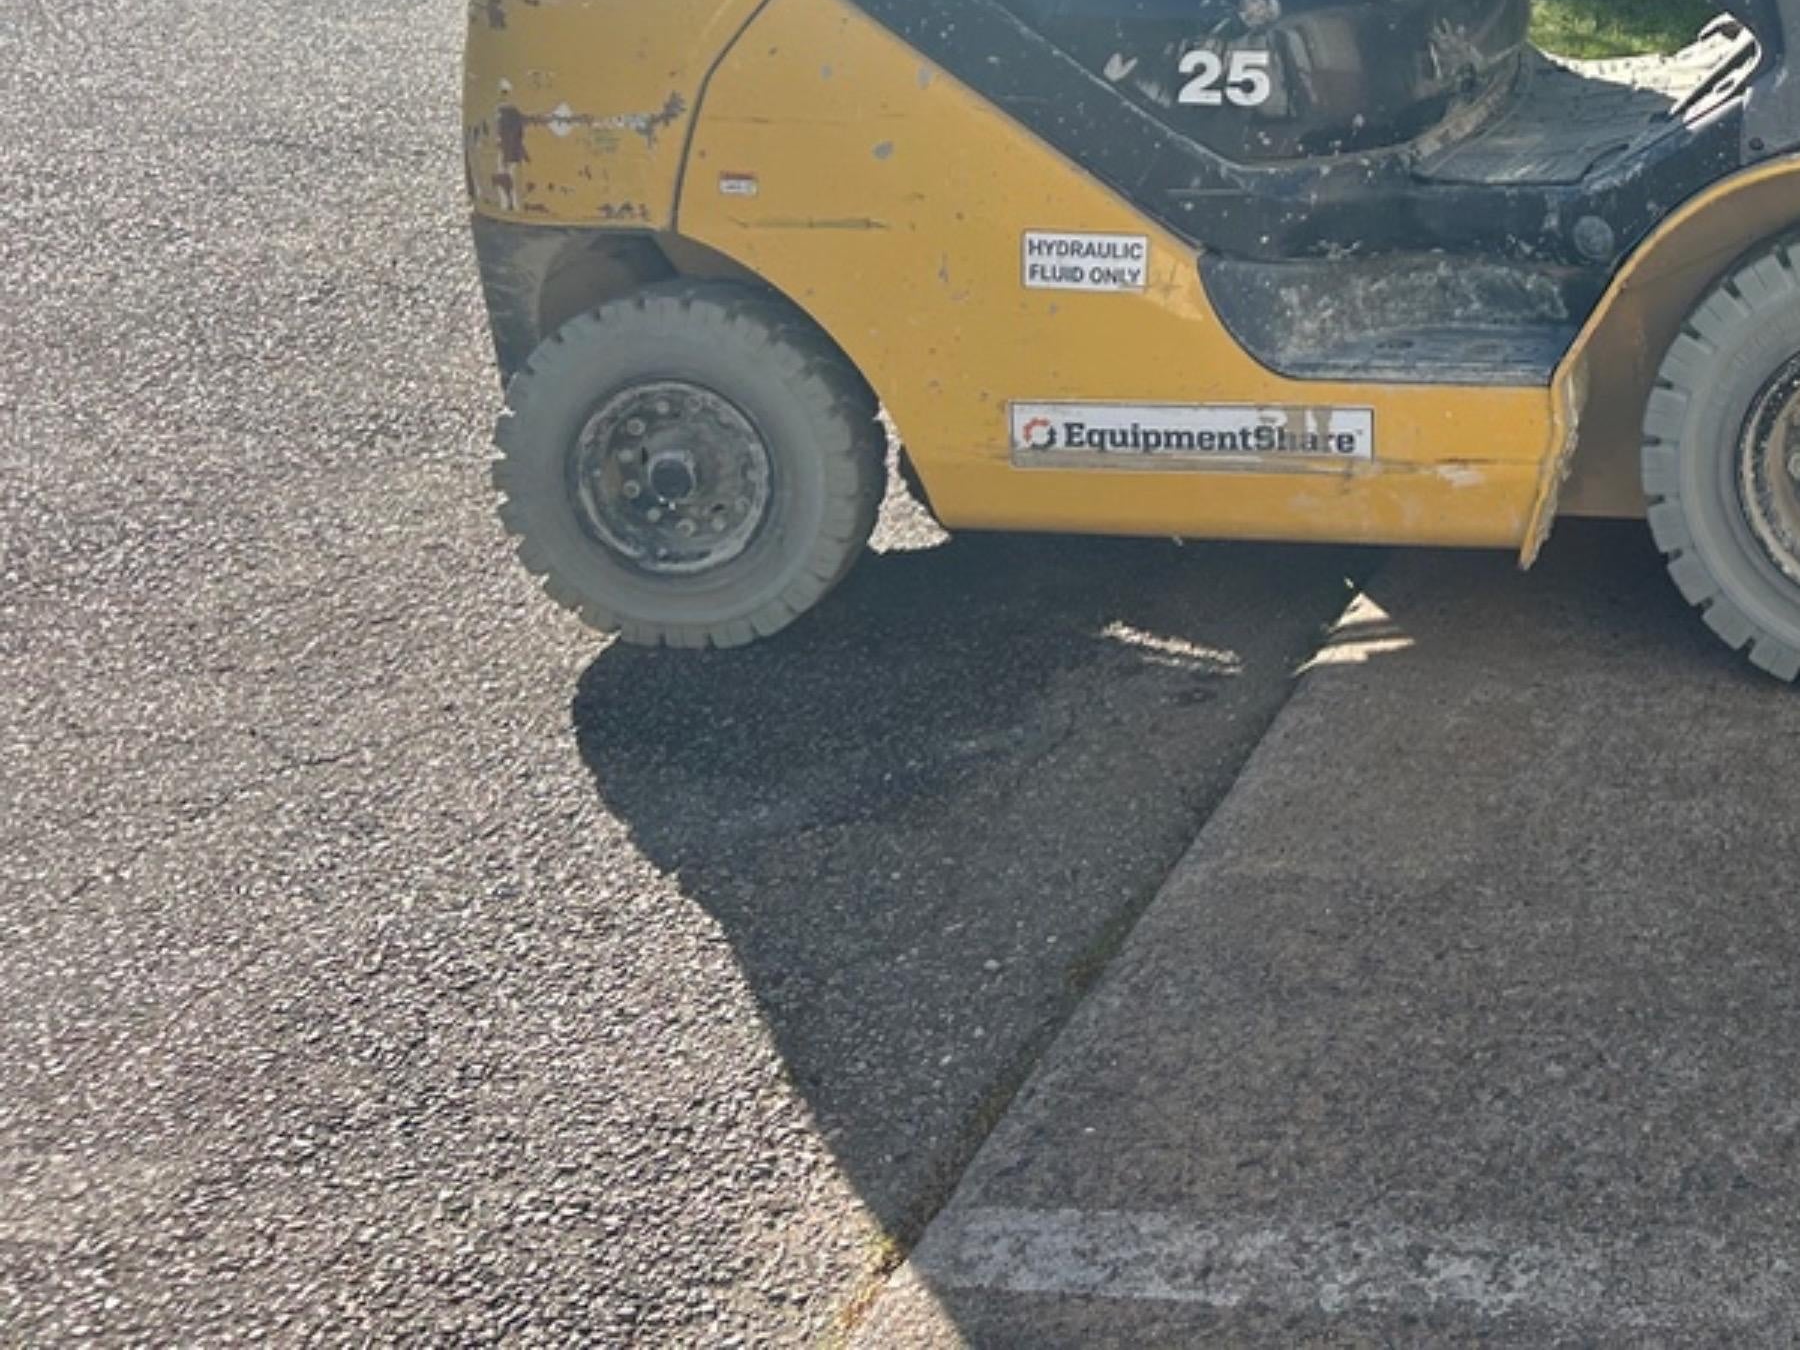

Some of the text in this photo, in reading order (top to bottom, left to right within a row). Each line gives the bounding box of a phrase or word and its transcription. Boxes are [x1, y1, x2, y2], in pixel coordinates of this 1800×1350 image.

[1178, 50, 1270, 106] 25
[1028, 238, 1144, 259] HYDRAULIC
[1029, 263, 1142, 285] FLUID ONLY
[1063, 422, 1356, 454] EquipmentShare
